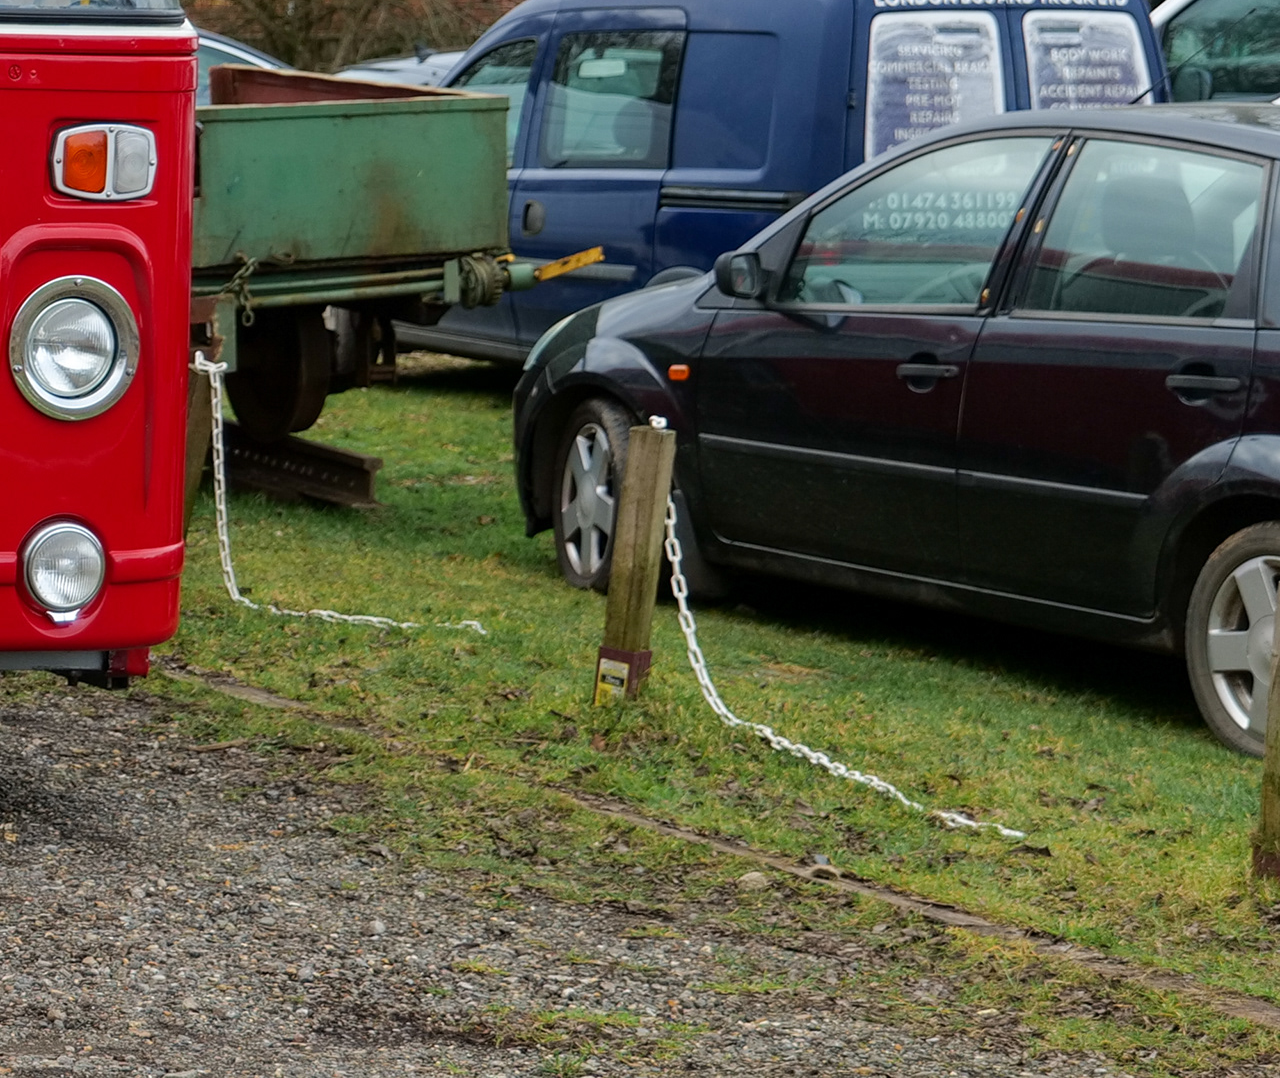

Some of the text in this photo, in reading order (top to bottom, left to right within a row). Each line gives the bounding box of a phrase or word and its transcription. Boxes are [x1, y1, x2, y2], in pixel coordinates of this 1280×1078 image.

[897, 44, 962, 57] SERVICING
[1050, 47, 1128, 62] BODY WORK
[1062, 66, 1121, 80] REPAINTS
[907, 76, 958, 90] TESTING
[1040, 84, 1103, 98] ACCIDENT
[910, 110, 959, 123] REPAIRS
[887, 191, 946, 209] 01474
[950, 191, 1017, 210] 361199
[890, 212, 948, 229] 07920
